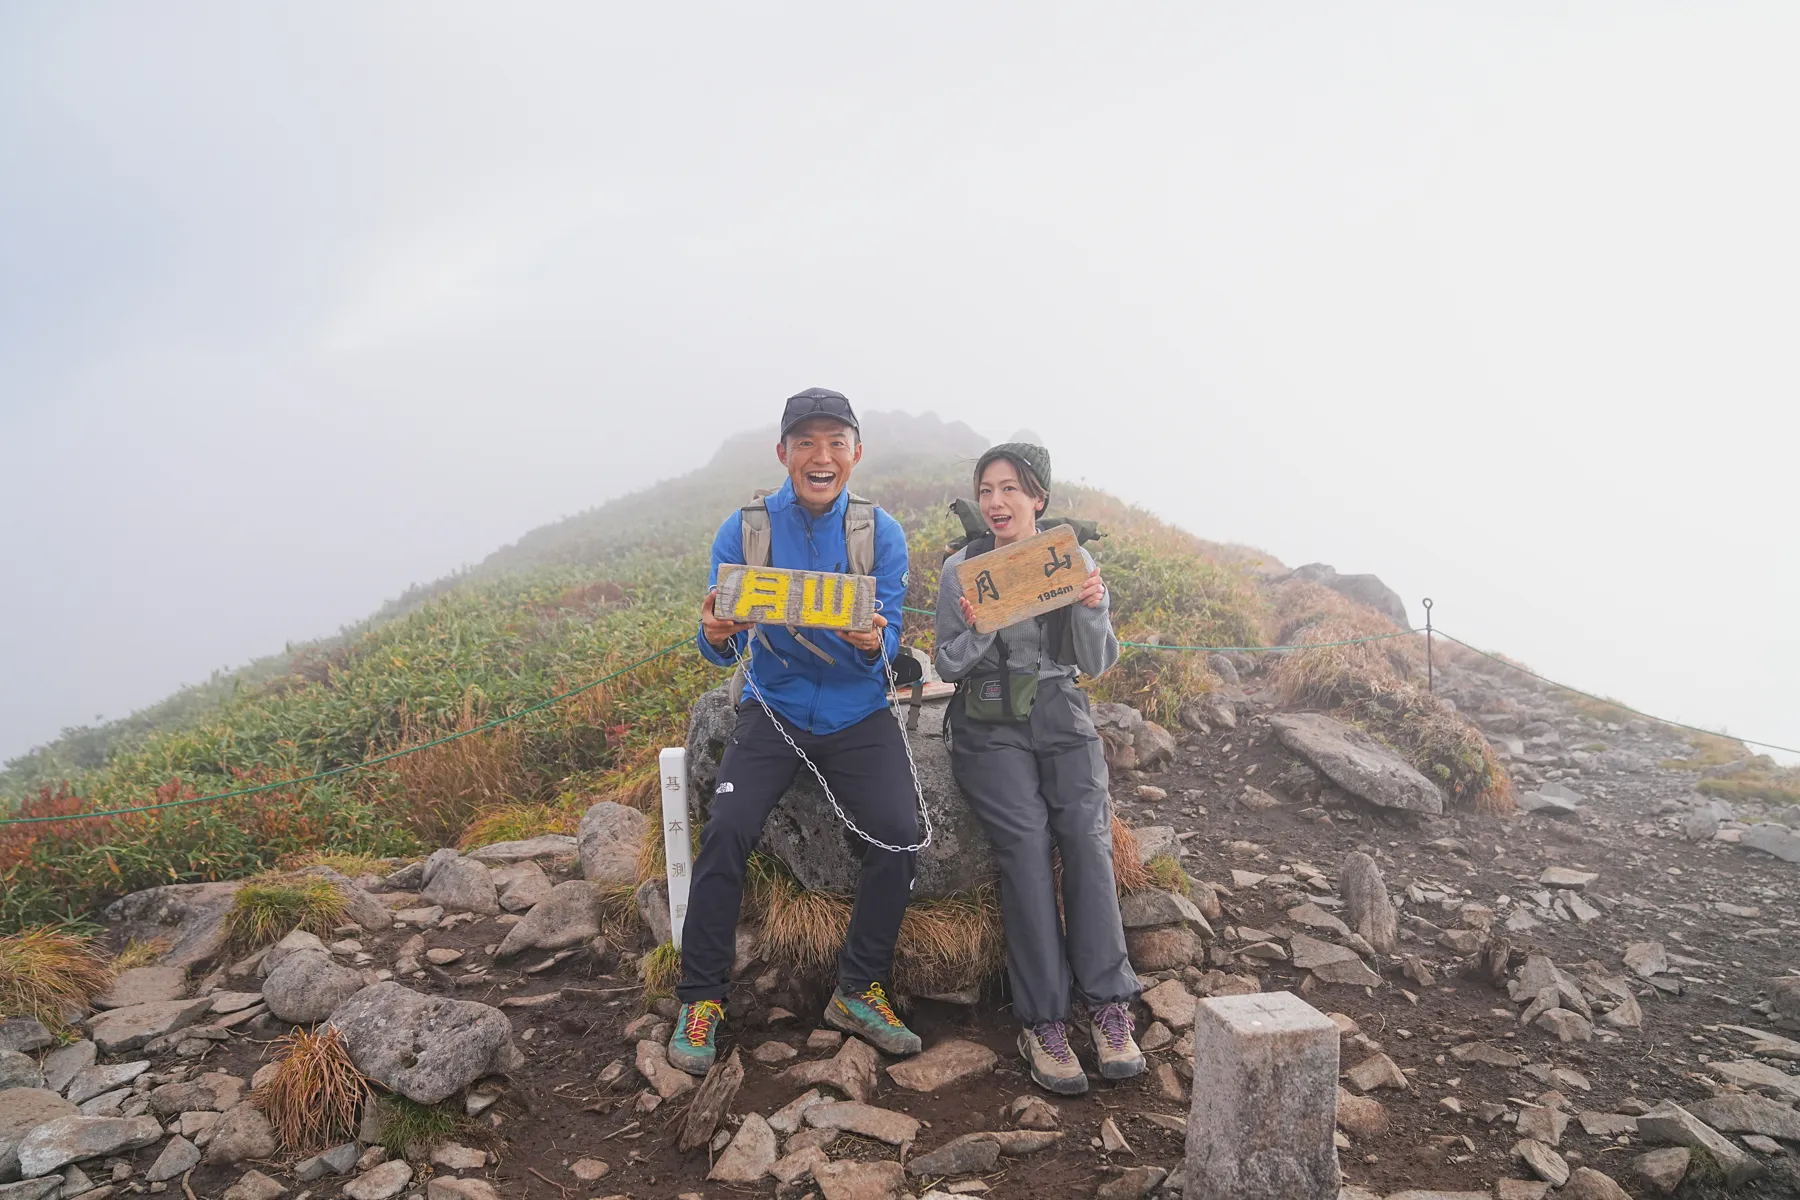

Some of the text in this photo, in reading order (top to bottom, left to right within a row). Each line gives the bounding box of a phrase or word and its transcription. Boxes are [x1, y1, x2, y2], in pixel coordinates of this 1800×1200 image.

[735, 569, 856, 627] 月山
[975, 546, 1072, 604] 月山
[1037, 584, 1074, 602] 1984m
